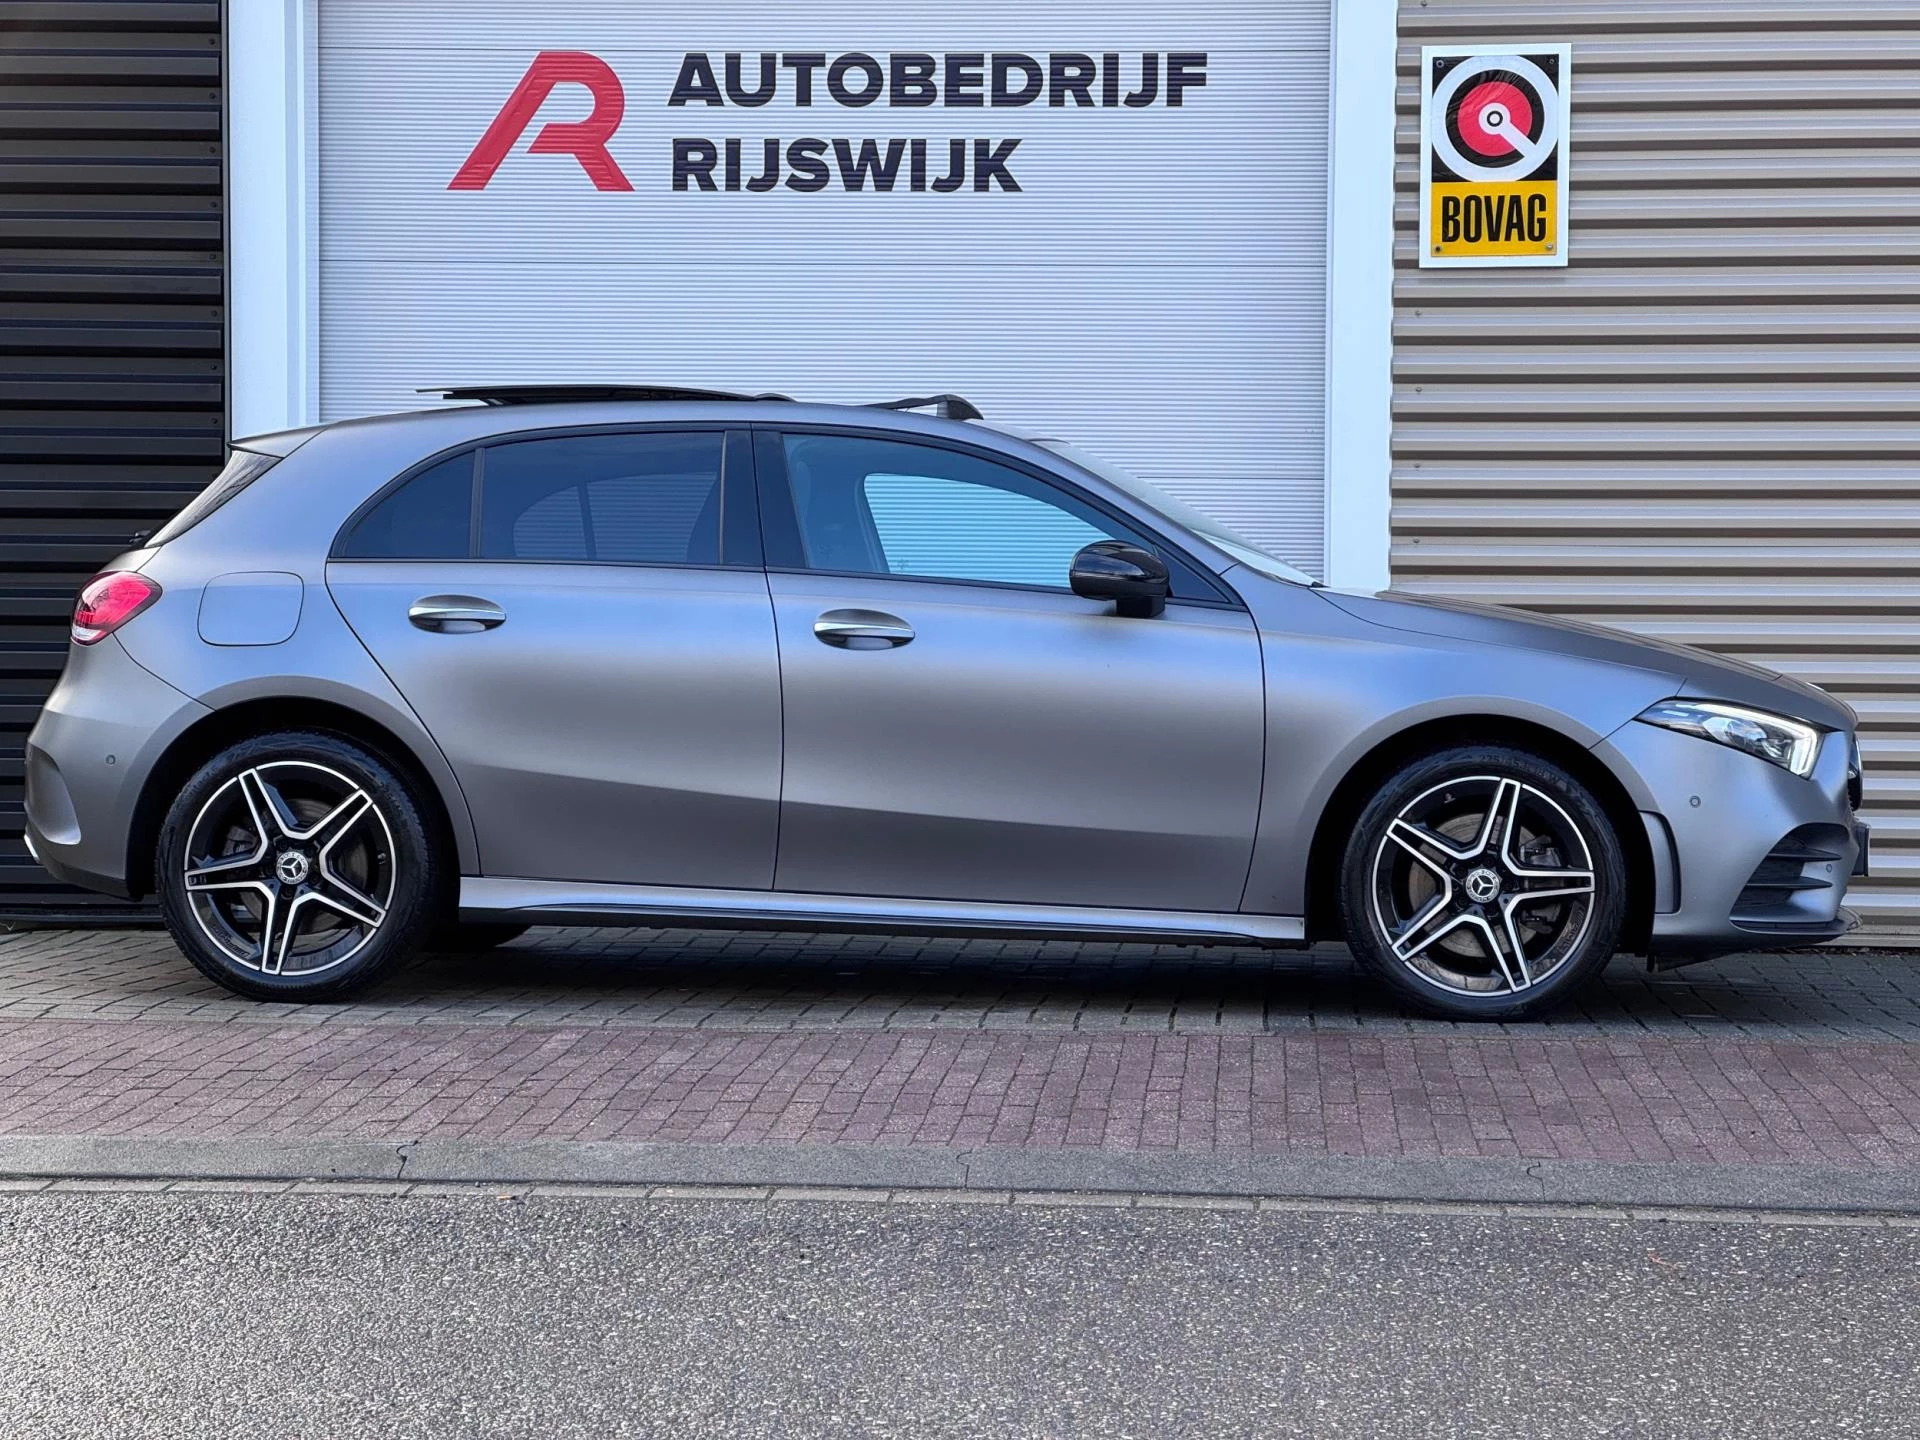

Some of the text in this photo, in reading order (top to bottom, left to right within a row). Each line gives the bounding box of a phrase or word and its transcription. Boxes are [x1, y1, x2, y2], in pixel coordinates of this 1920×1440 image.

[668, 52, 1208, 108] AUTOBEDRIJF
[672, 137, 1023, 193] RIJSWIJK
[1441, 193, 1547, 243] BOVAG
